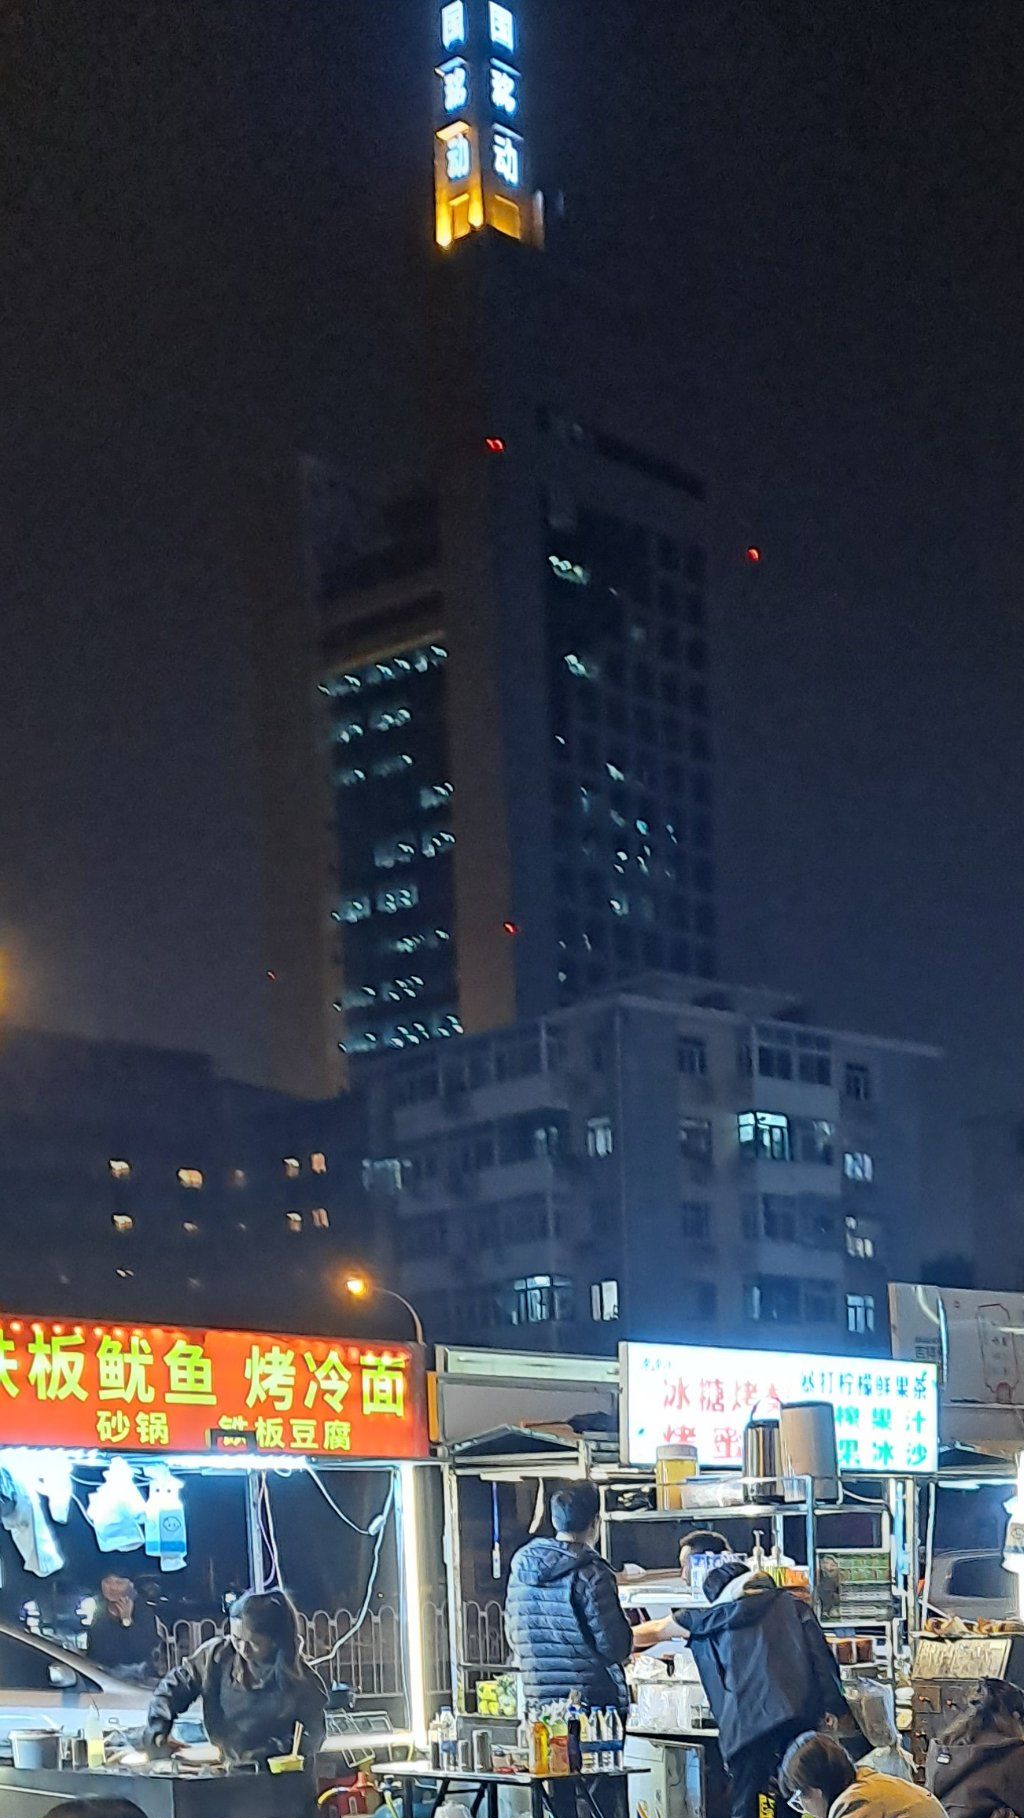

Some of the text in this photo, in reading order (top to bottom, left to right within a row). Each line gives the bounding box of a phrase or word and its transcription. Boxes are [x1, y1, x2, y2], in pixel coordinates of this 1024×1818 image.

[244, 1344, 408, 1417] 烤冷面
[96, 1410, 169, 1445] 砂锅
